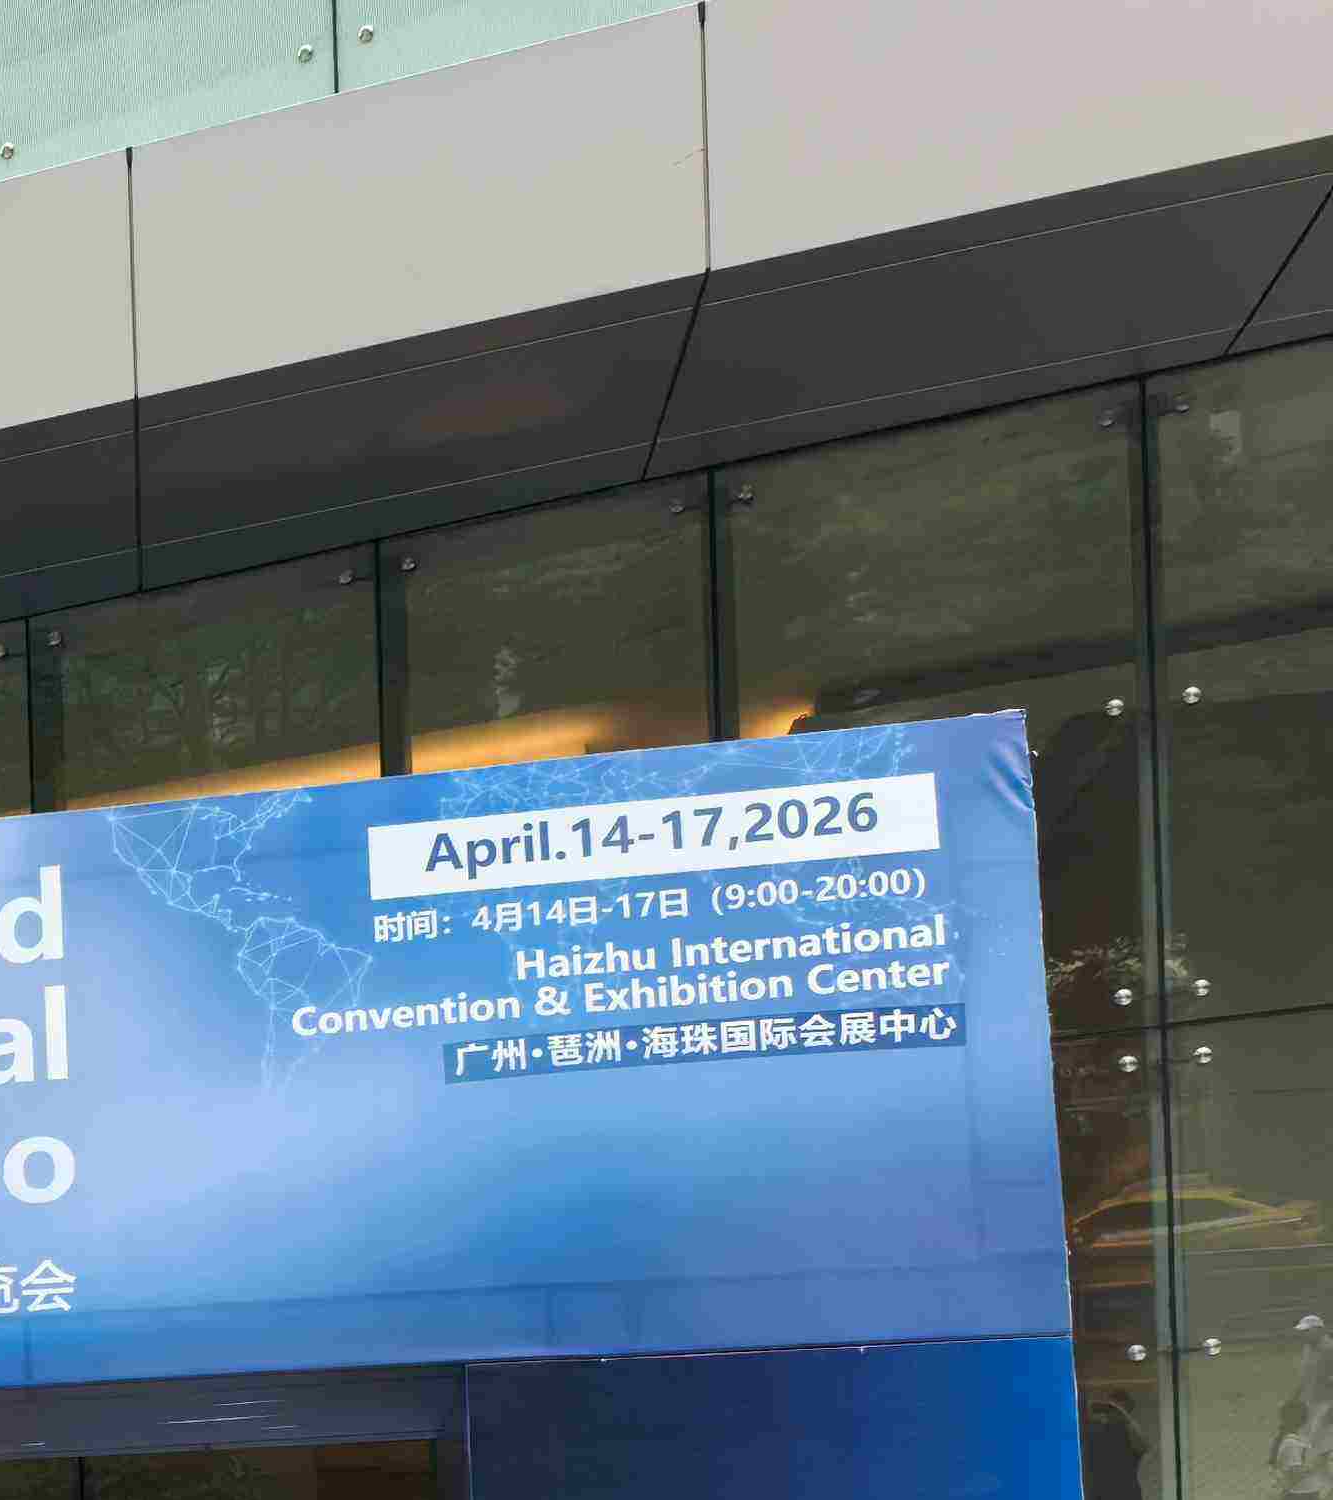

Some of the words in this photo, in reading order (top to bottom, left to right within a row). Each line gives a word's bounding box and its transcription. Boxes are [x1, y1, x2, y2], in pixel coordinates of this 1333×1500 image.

[425, 791, 879, 879] April.14-17,2026
[516, 937, 658, 980] Haizhu
[671, 914, 948, 966] International
[291, 991, 521, 1037] Convention
[535, 986, 571, 1016] &
[584, 966, 794, 1014] Exhibition
[807, 961, 950, 996] Center
